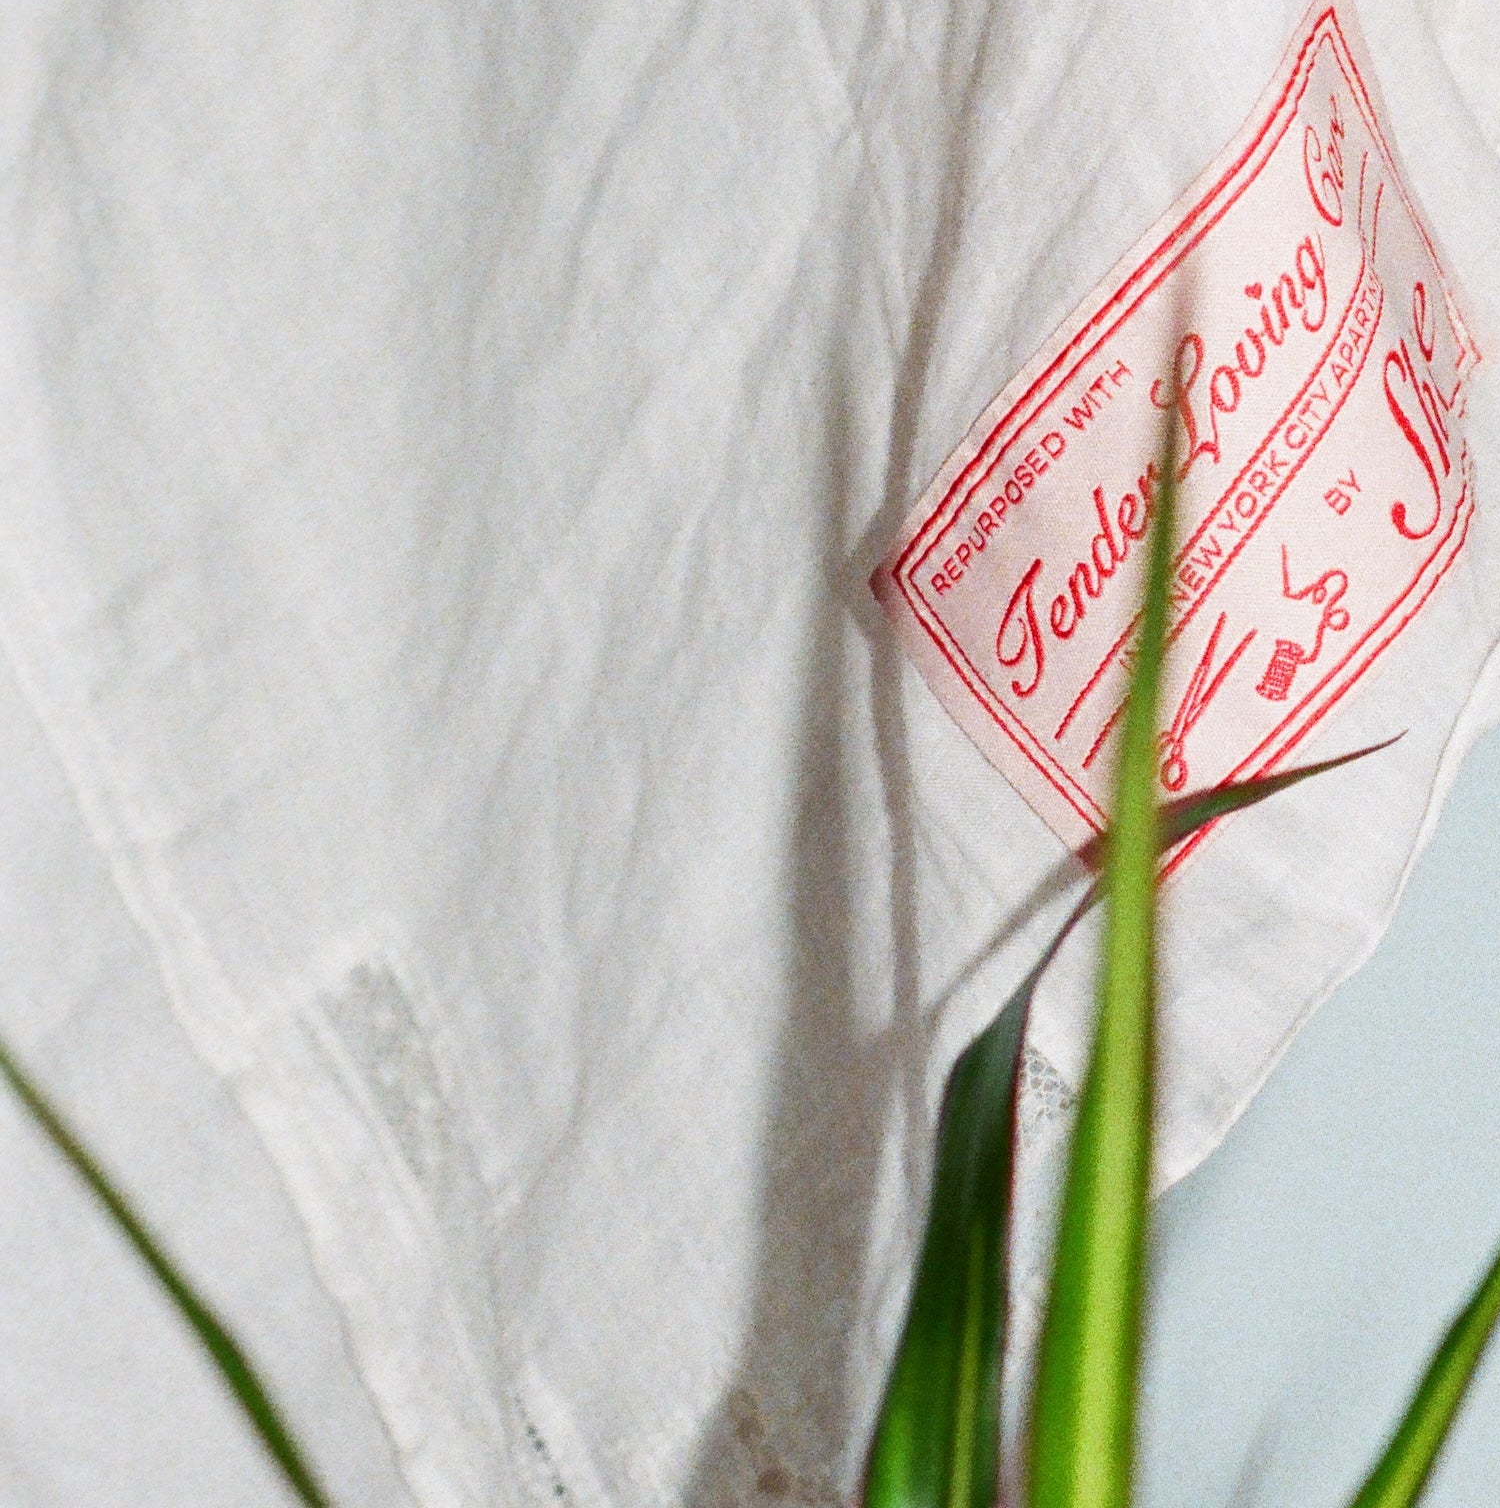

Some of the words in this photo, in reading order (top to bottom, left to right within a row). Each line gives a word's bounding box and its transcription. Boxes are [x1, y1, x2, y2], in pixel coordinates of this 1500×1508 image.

[931, 430, 1067, 596] REPURPOSED
[1062, 359, 1135, 432] WITH
[996, 460, 1162, 698] Tender
[1149, 228, 1328, 484] Loving
[1168, 534, 1224, 613] NEW
[1215, 449, 1290, 533] YORK
[1284, 378, 1332, 450] CITY
[1330, 272, 1379, 389] APARTM
[1322, 466, 1362, 516] BY
